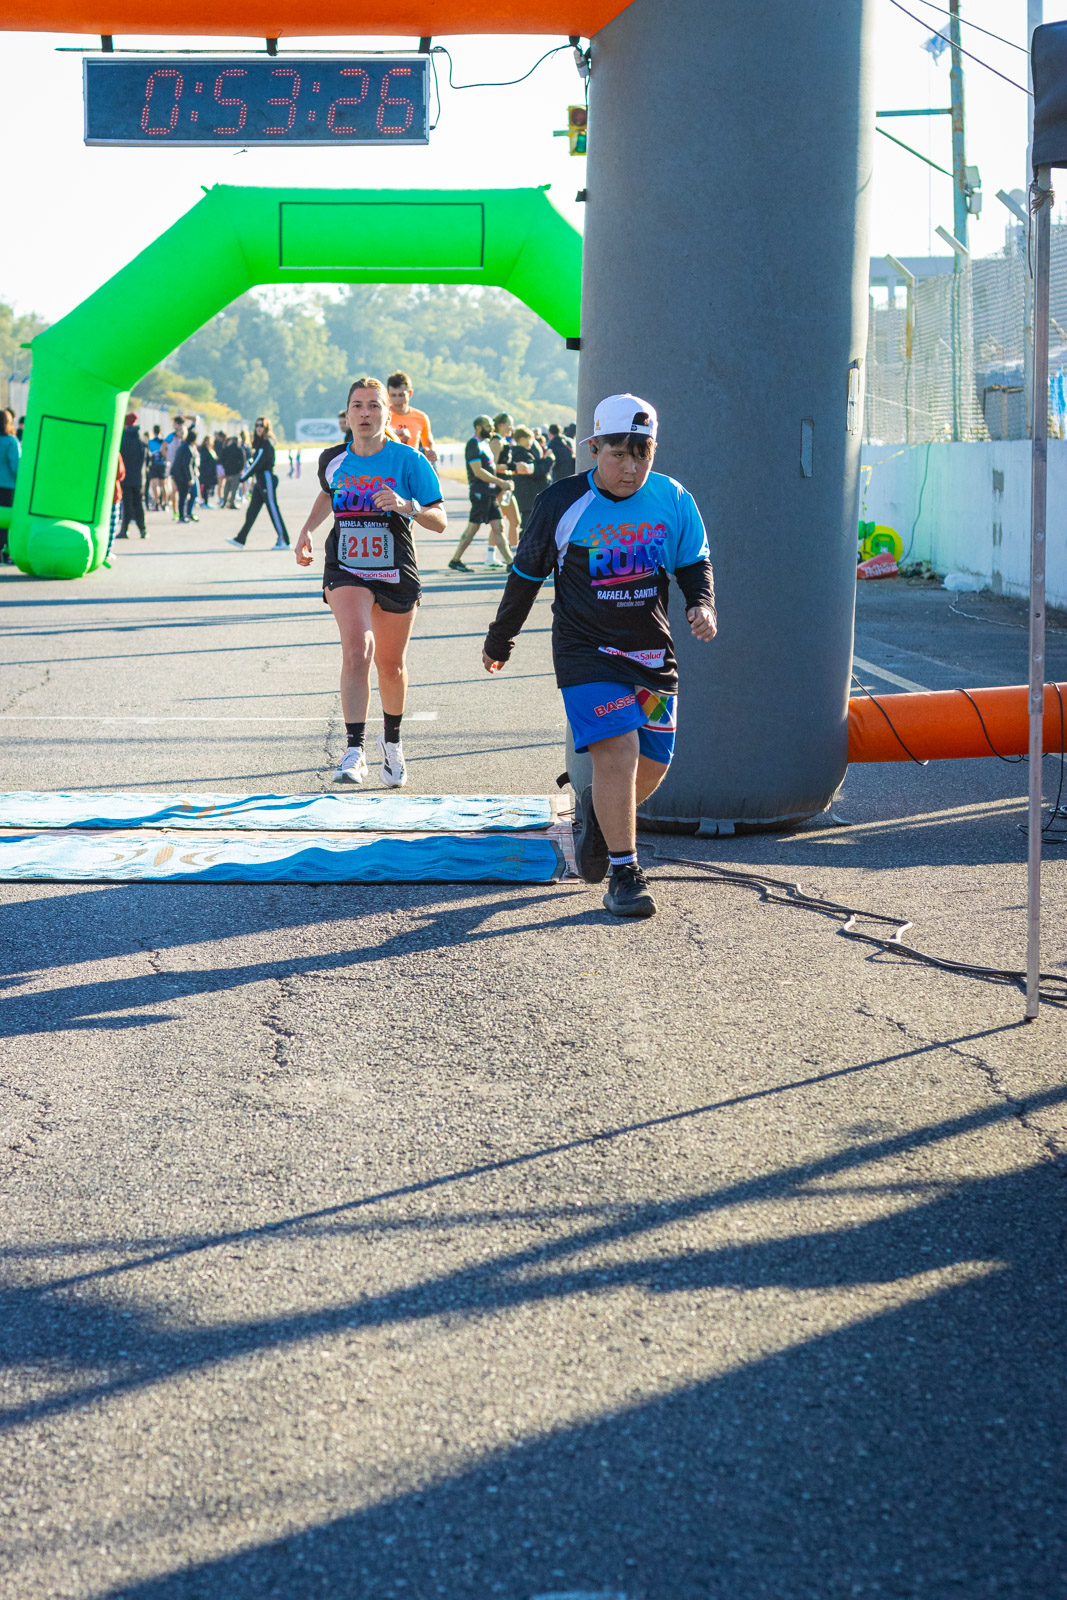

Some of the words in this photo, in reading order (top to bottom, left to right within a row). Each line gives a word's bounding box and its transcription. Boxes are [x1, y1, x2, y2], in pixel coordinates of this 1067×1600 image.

[140, 68, 415, 135] 0:53:26
[347, 536, 383, 558] 215
[597, 590, 632, 600] RAFAELA,
[640, 652, 662, 661] Salud
